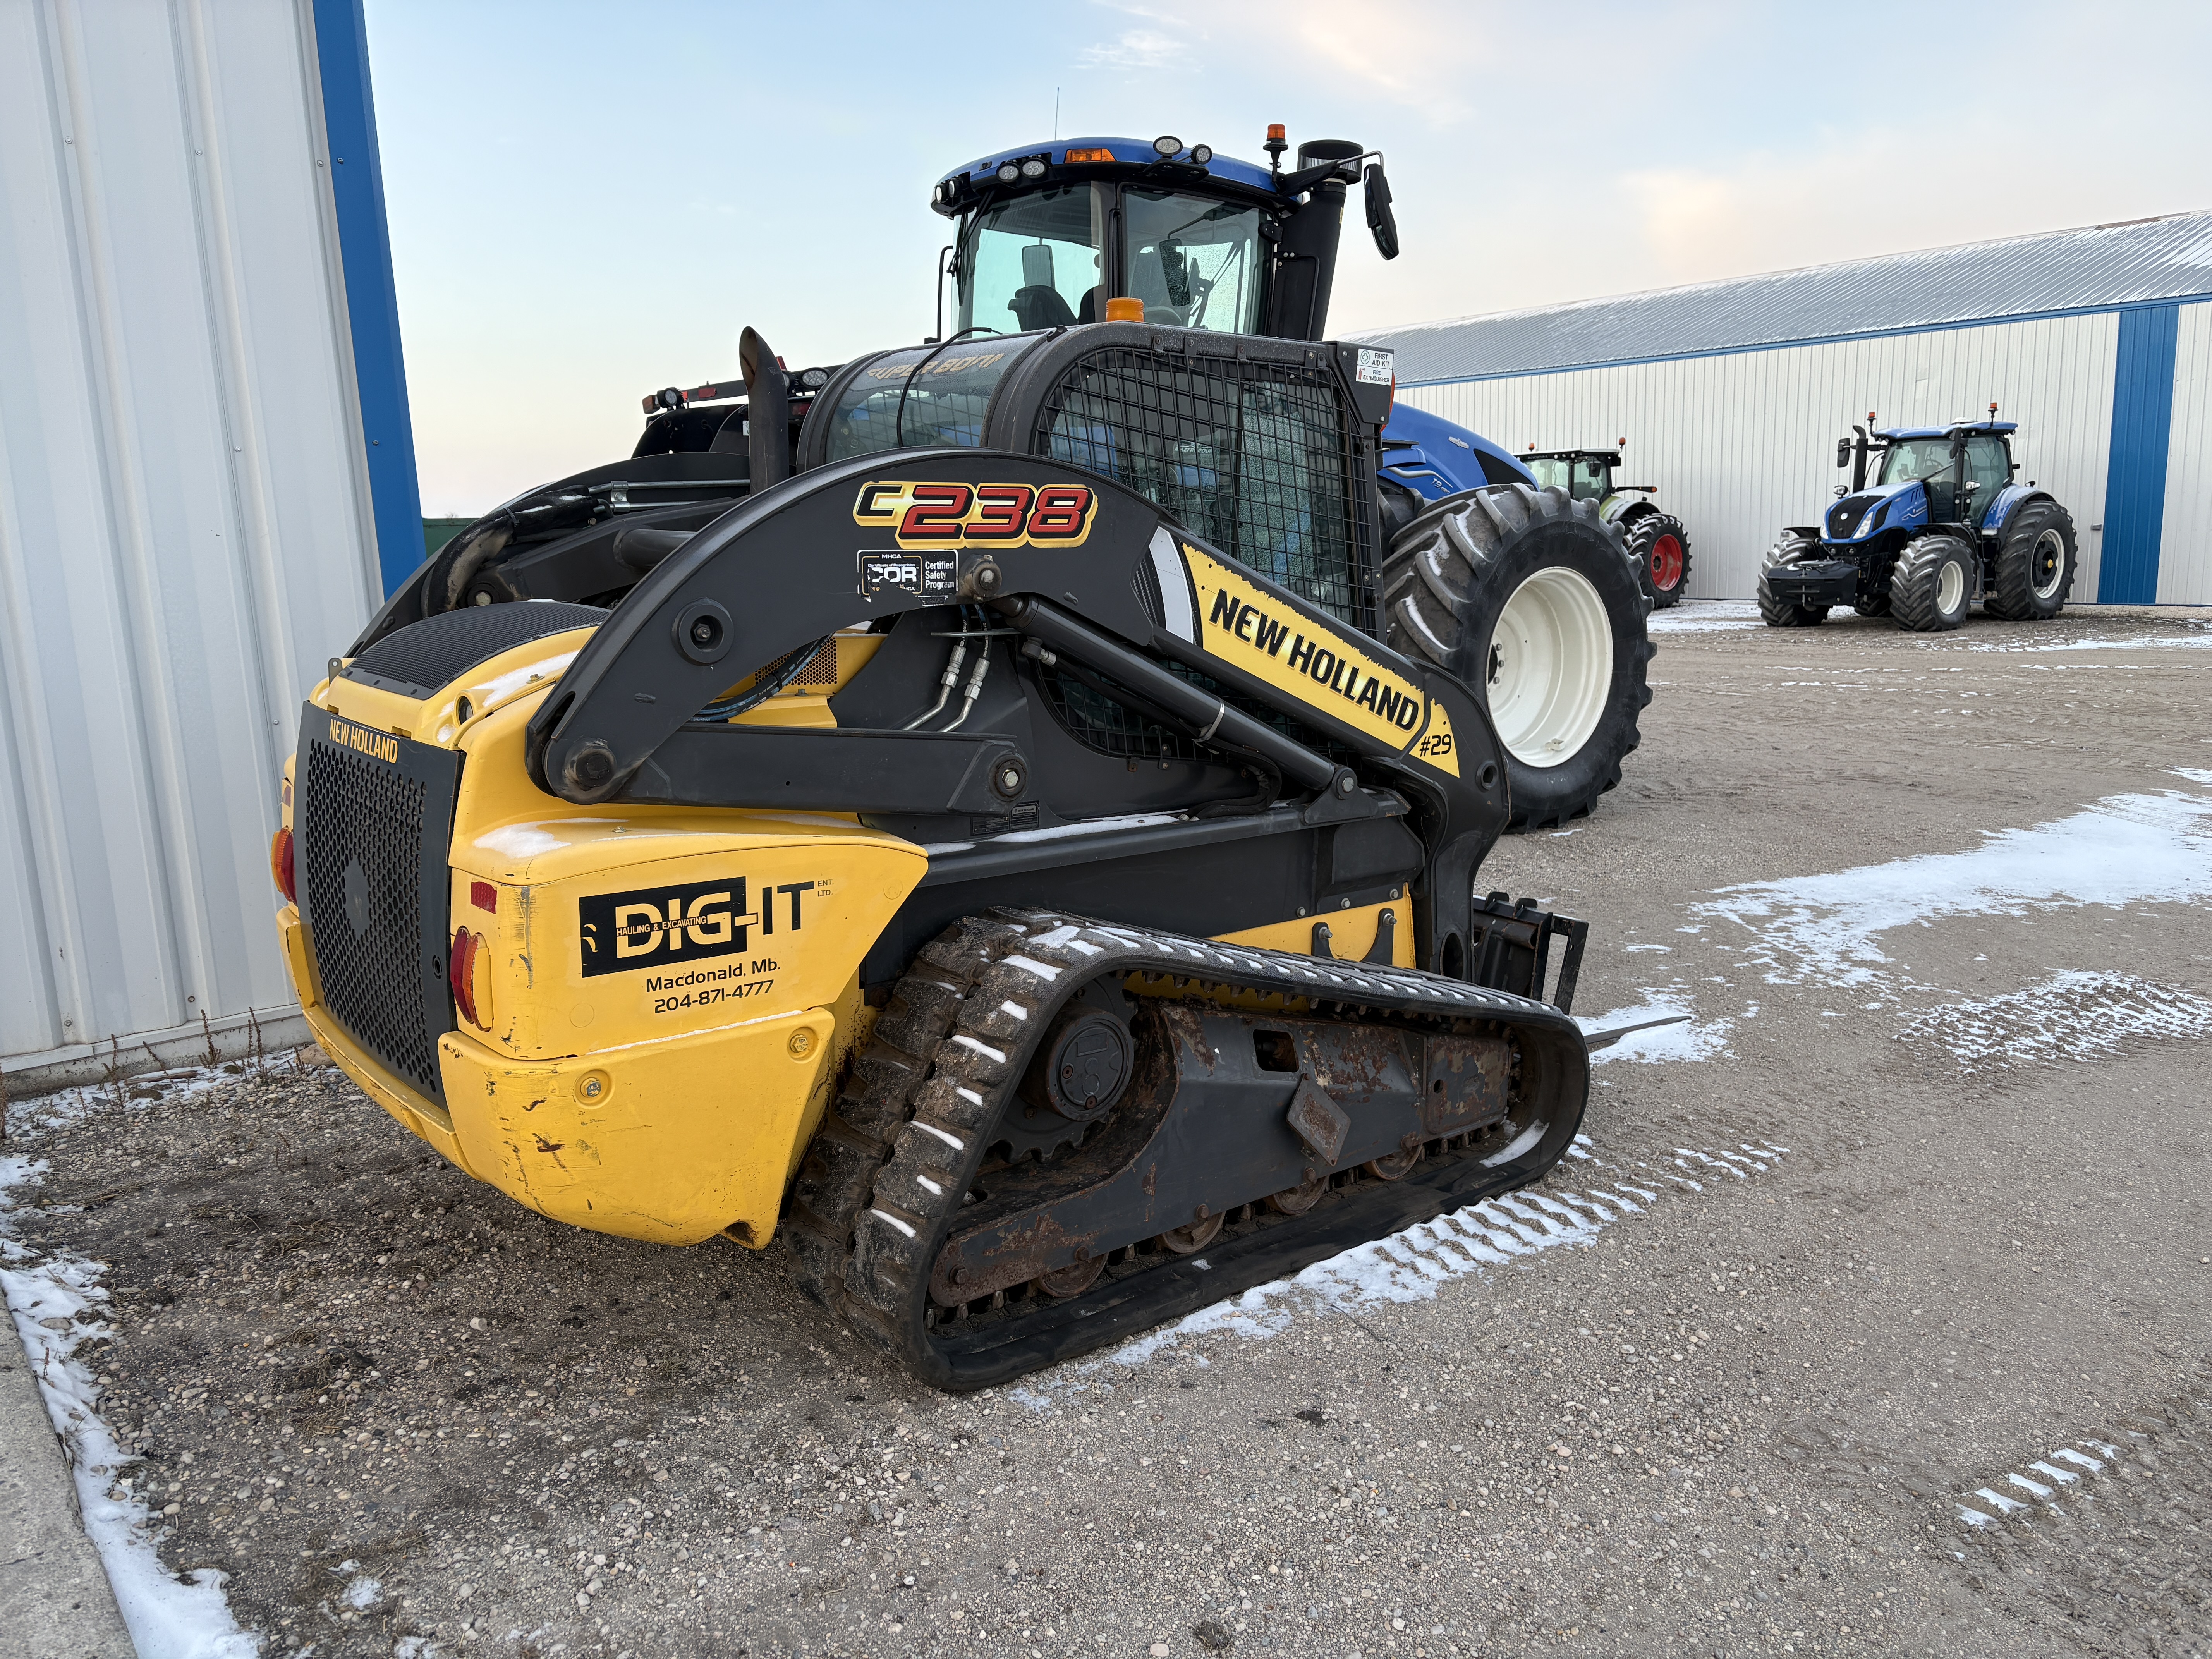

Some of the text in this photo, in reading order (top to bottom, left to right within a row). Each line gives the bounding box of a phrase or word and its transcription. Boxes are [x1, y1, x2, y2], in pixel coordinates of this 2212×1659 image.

[1363, 374, 1390, 383] EXTINGUISHER
[856, 484, 1095, 540] C238
[867, 567, 917, 583] COR
[925, 561, 954, 570] Certified
[925, 570, 947, 580] Safety
[925, 581, 954, 590] Program
[1209, 587, 1419, 731] NEW HOLLAND
[329, 718, 398, 764] NEW HOLLAND
[1420, 733, 1452, 757] #29
[817, 879, 834, 887] ENT.
[617, 916, 707, 936] HAULING & EXCAVATING
[646, 958, 780, 992] Macdonald, Mb.
[654, 979, 774, 1013] 204-871-4777
